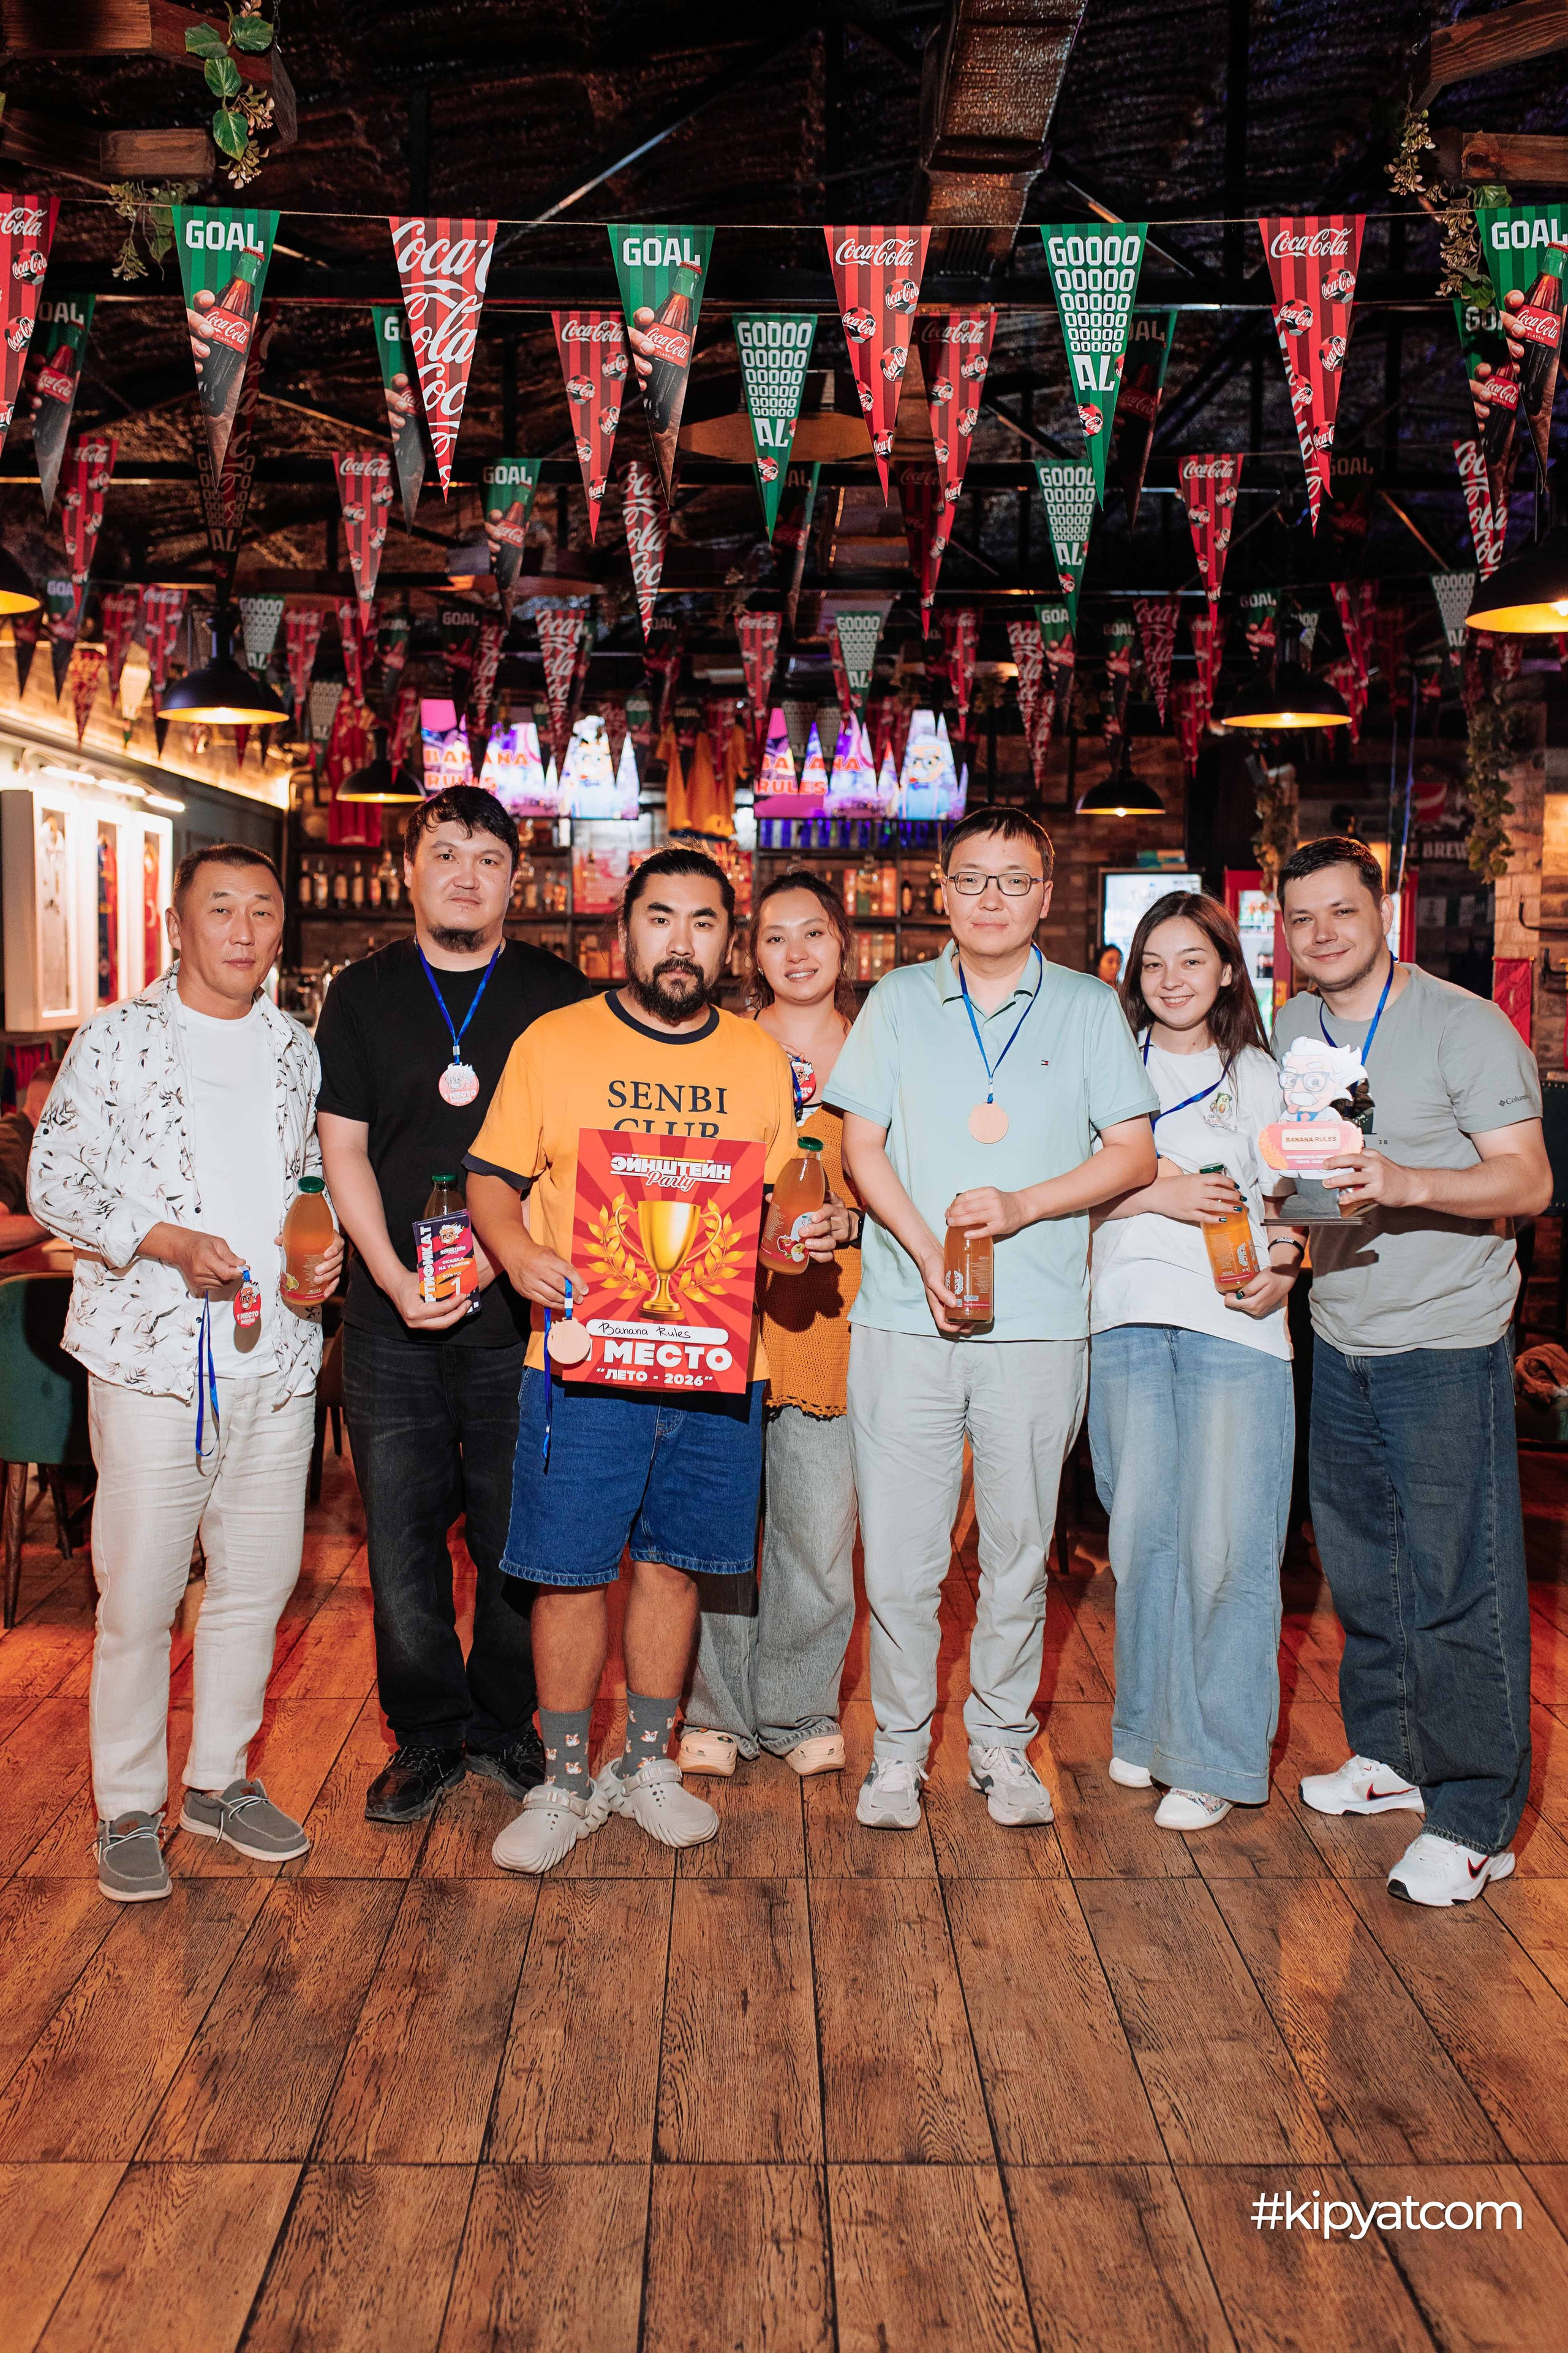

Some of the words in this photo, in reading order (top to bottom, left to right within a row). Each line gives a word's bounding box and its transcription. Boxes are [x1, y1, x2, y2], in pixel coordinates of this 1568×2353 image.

[186, 219, 264, 252] GOAL
[1270, 227, 1353, 259] Coca-Cola
[1491, 218, 1568, 250] GOAL
[623, 237, 701, 266] GOAL
[835, 238, 919, 267] Coca-Cola
[1048, 235, 1141, 266] GOOOO
[39, 301, 85, 324] OAL
[737, 322, 813, 348] GOOOO
[1072, 355, 1115, 391] AL
[753, 418, 789, 447] AL
[483, 465, 533, 485] GOAL
[1055, 542, 1083, 565] AL
[1041, 608, 1069, 624] GOA
[608, 1080, 728, 1114] SENBI
[611, 1154, 731, 1180] ЭЙНШТЕЙН
[645, 1171, 696, 1192] Party
[420, 1226, 437, 1304] РТИФИКАТ
[240, 1310, 259, 1320] МЕСТО
[598, 1321, 648, 1335] Banana
[655, 1326, 692, 1339] Rules
[603, 1340, 733, 1372] МЕСТО
